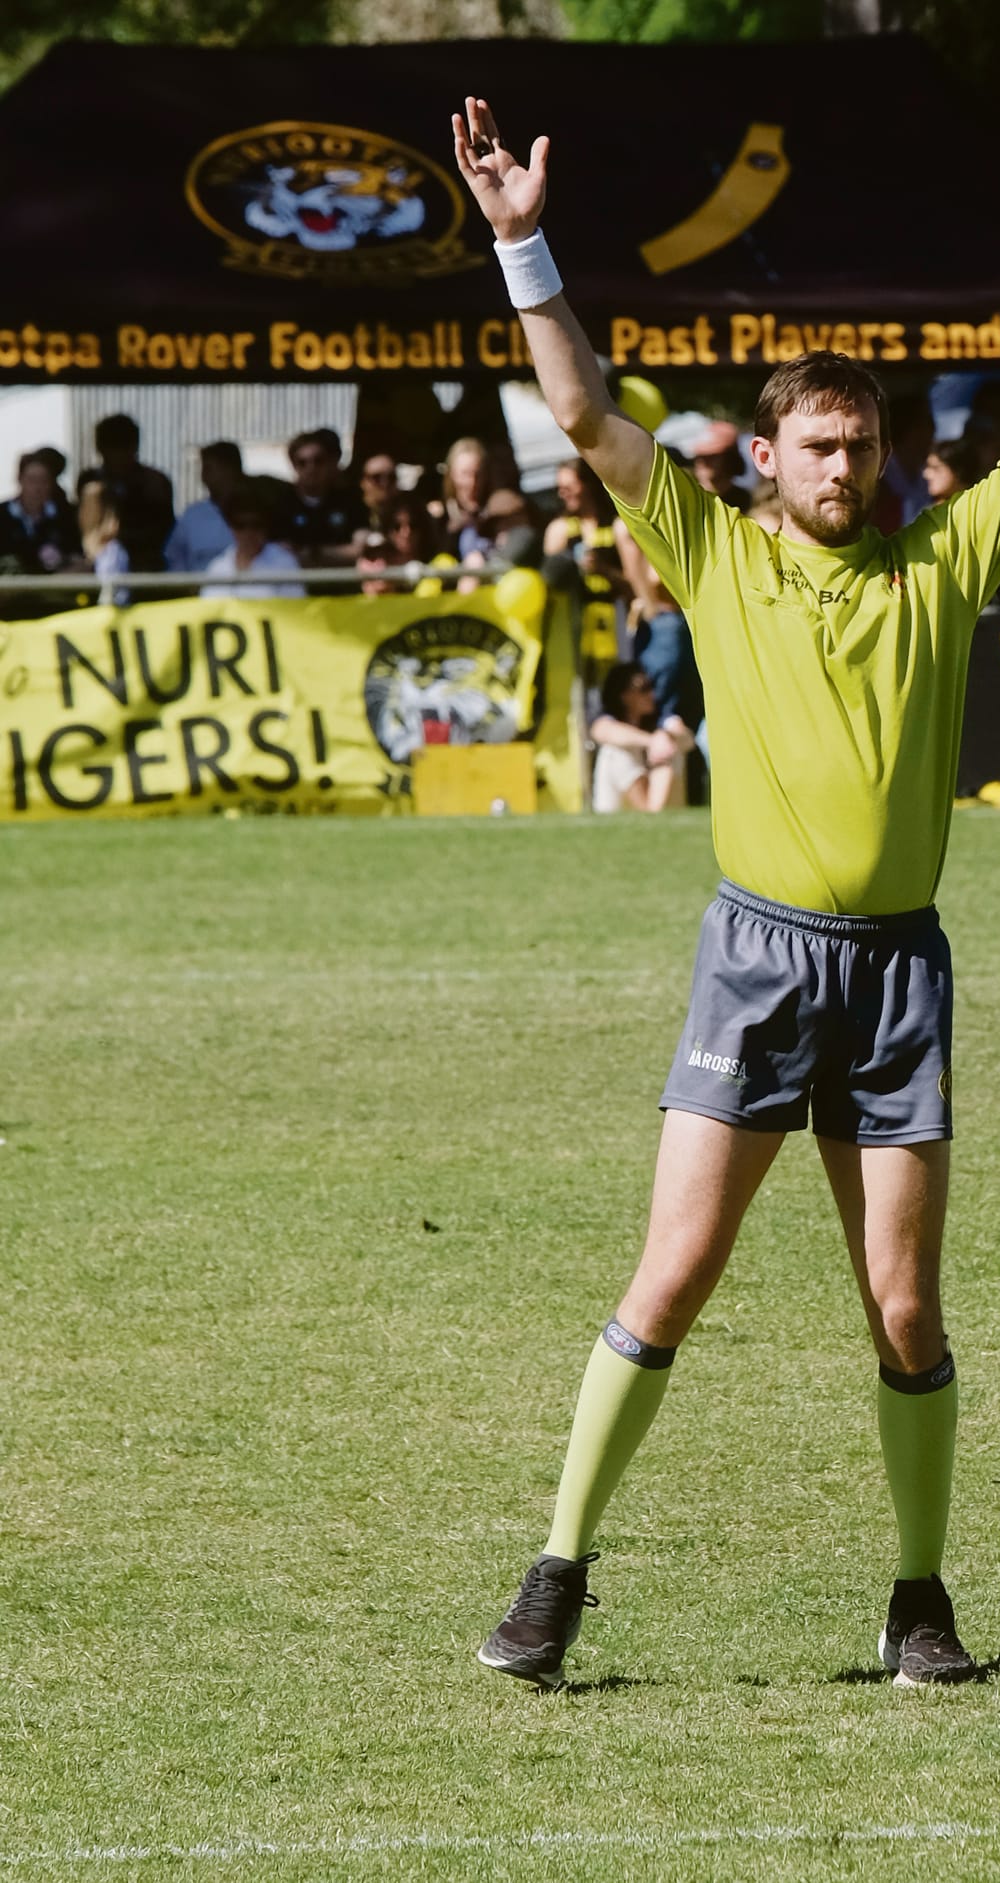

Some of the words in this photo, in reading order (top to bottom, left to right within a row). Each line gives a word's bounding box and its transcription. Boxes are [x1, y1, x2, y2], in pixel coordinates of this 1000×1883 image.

[117, 324, 255, 370] Rover
[269, 321, 464, 371] Football
[611, 314, 718, 366] Past
[55, 619, 281, 709] NURI
[9, 709, 333, 811] IGERS!
